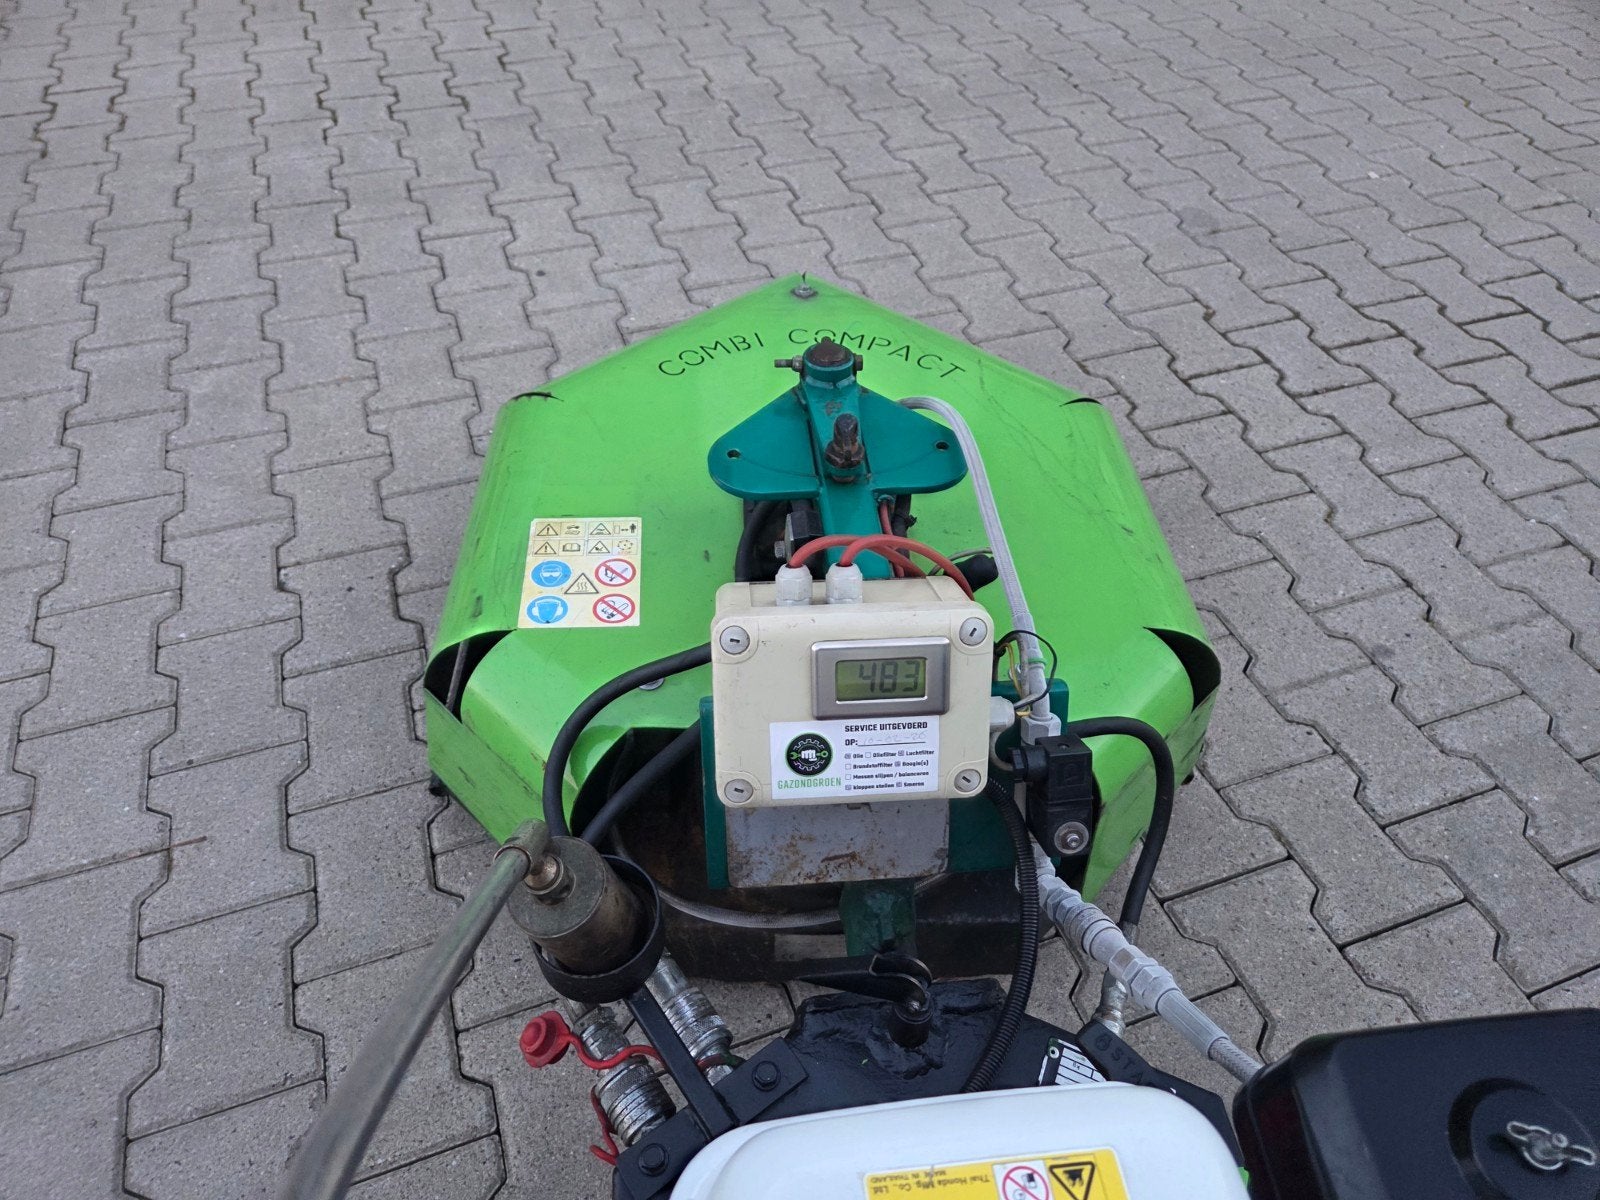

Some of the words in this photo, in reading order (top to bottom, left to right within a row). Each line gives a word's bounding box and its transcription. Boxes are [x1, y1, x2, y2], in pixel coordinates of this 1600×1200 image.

[658, 332, 764, 376] COMBI
[788, 328, 966, 379] COMPACT
[859, 661, 920, 693] 483
[844, 724, 877, 733] SERVICE
[879, 722, 928, 732] UITGEVOERD
[937, 1177, 967, 1187] Honda
[969, 1174, 990, 1184] Thai
